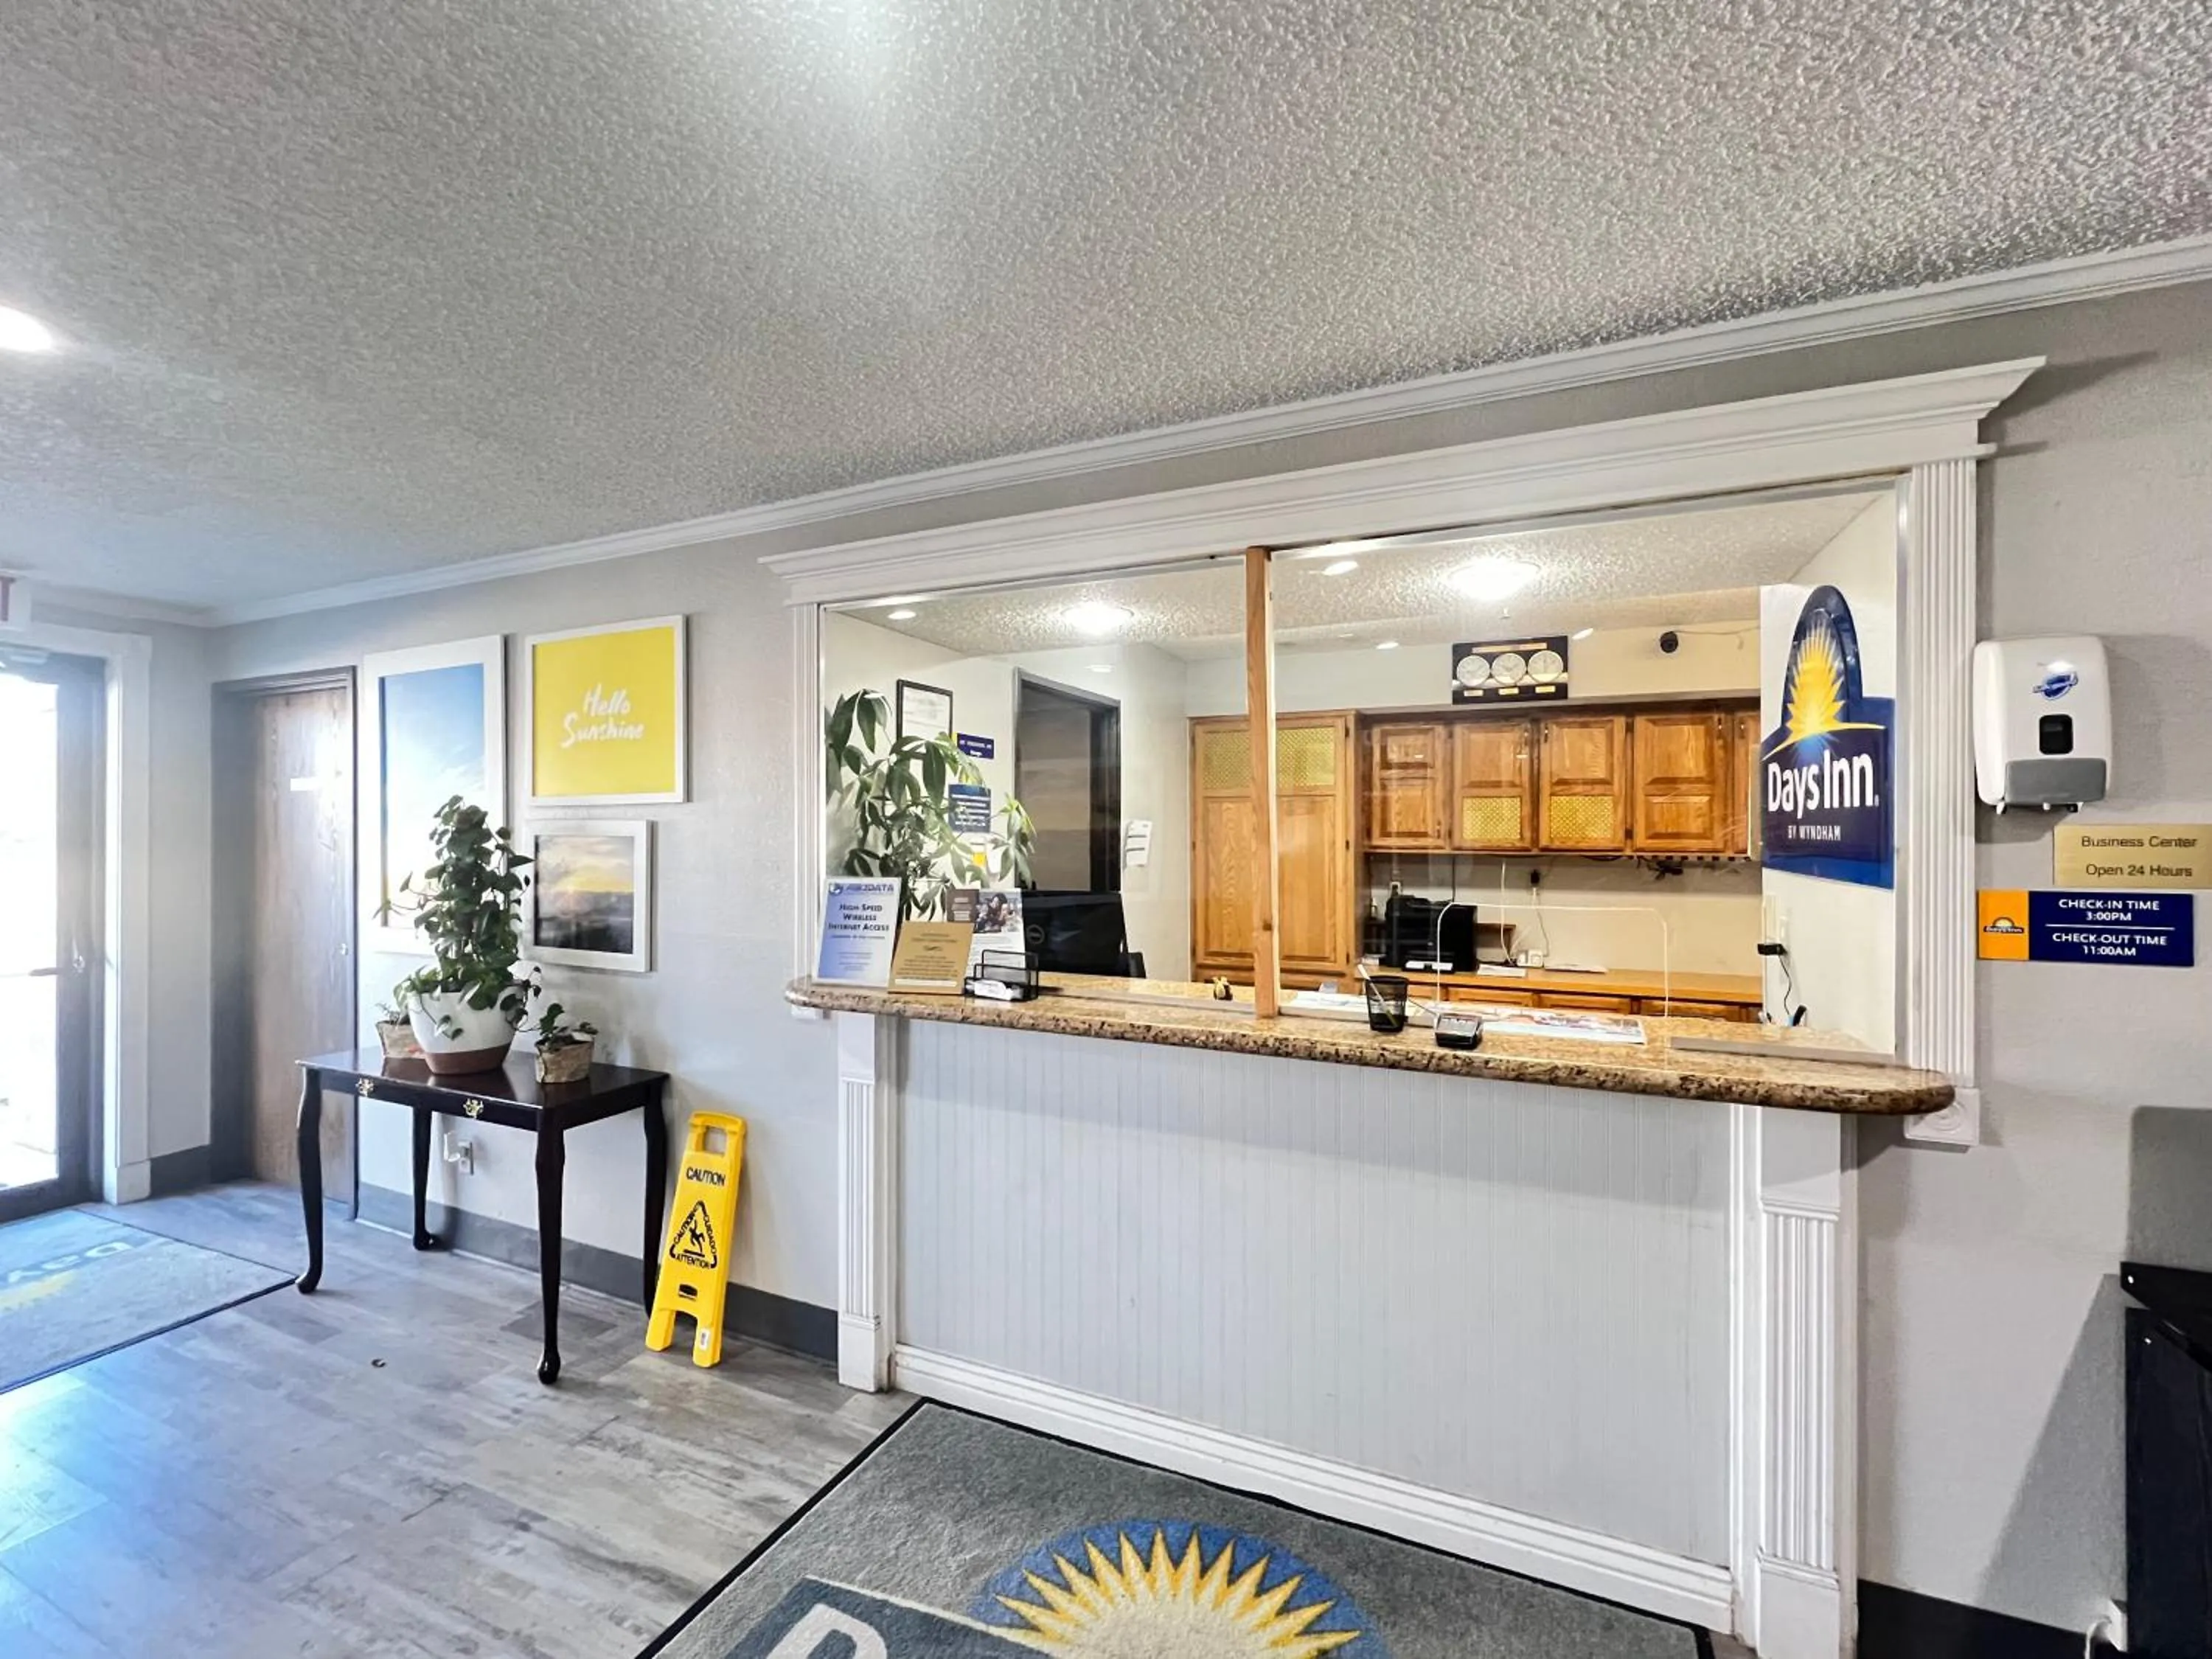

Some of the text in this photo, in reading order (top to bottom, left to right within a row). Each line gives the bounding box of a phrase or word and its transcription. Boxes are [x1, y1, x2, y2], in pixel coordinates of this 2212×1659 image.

[582, 682, 631, 717] Hello
[560, 712, 645, 748] Sunshine
[1767, 749, 1874, 819] Days Inn
[1799, 825, 1841, 841] WYNDHAM
[2081, 835, 2197, 848] Business Center
[2086, 863, 2192, 877] Open 24 Hours
[2059, 899, 2160, 911] CHECK-IN TIME
[2085, 911, 2132, 922] 3:00PM
[2052, 933, 2168, 946] CHECK-OUT TIME
[2082, 946, 2136, 956] 11:00AM
[686, 1166, 726, 1186] CAUTION
